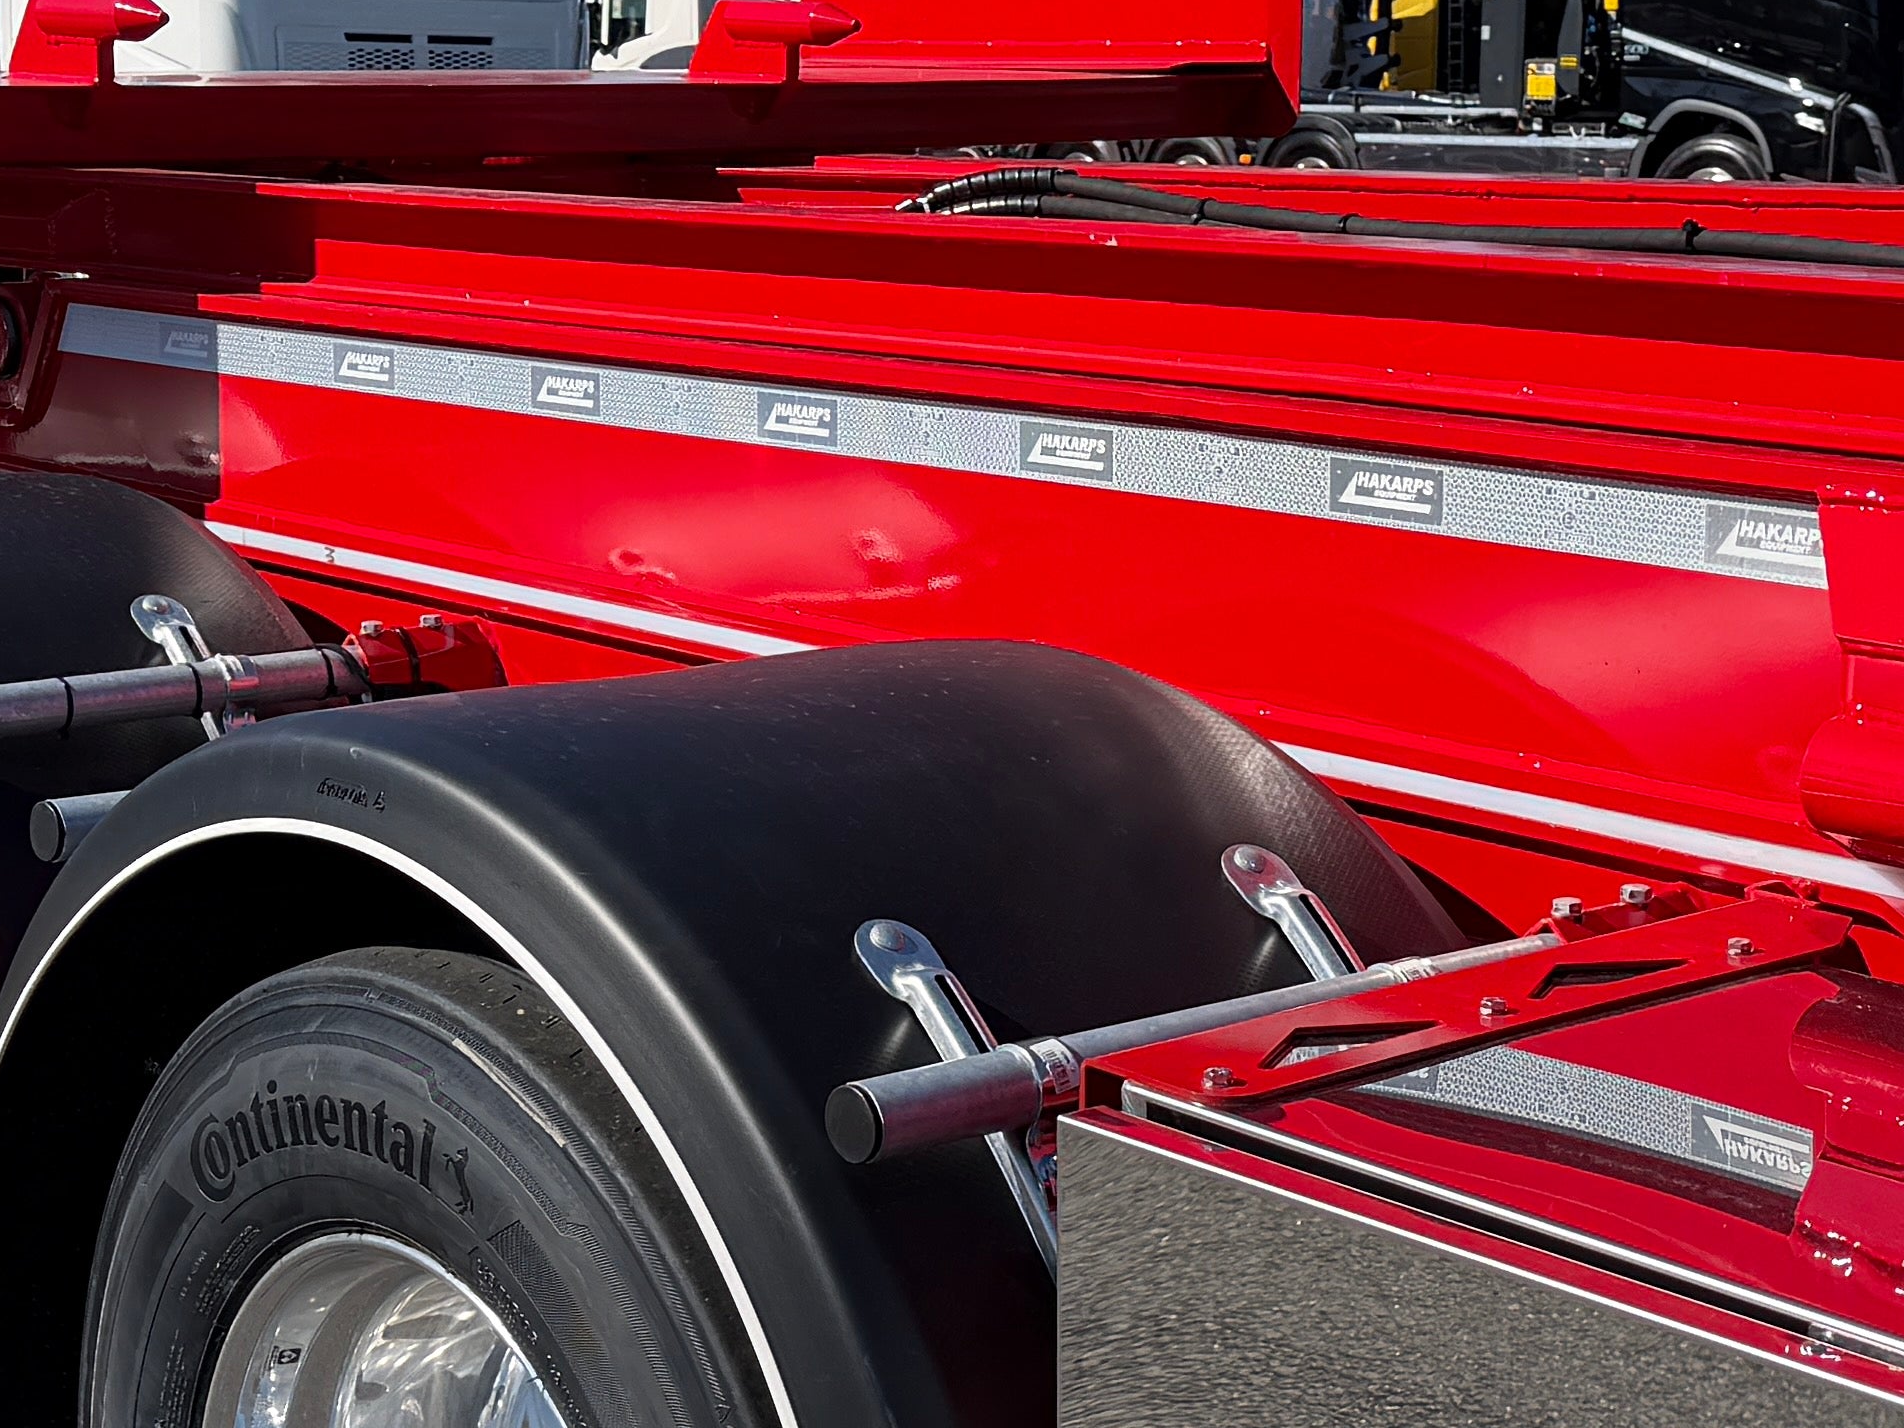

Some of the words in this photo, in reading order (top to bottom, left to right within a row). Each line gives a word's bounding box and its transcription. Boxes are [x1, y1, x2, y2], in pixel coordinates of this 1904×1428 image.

[776, 402, 831, 422] HAKARPS
[1042, 433, 1107, 454] HAKARPS
[1357, 471, 1435, 496] HAKARPS
[1739, 519, 1824, 550] HAKARP
[189, 1080, 437, 1204] Continental
